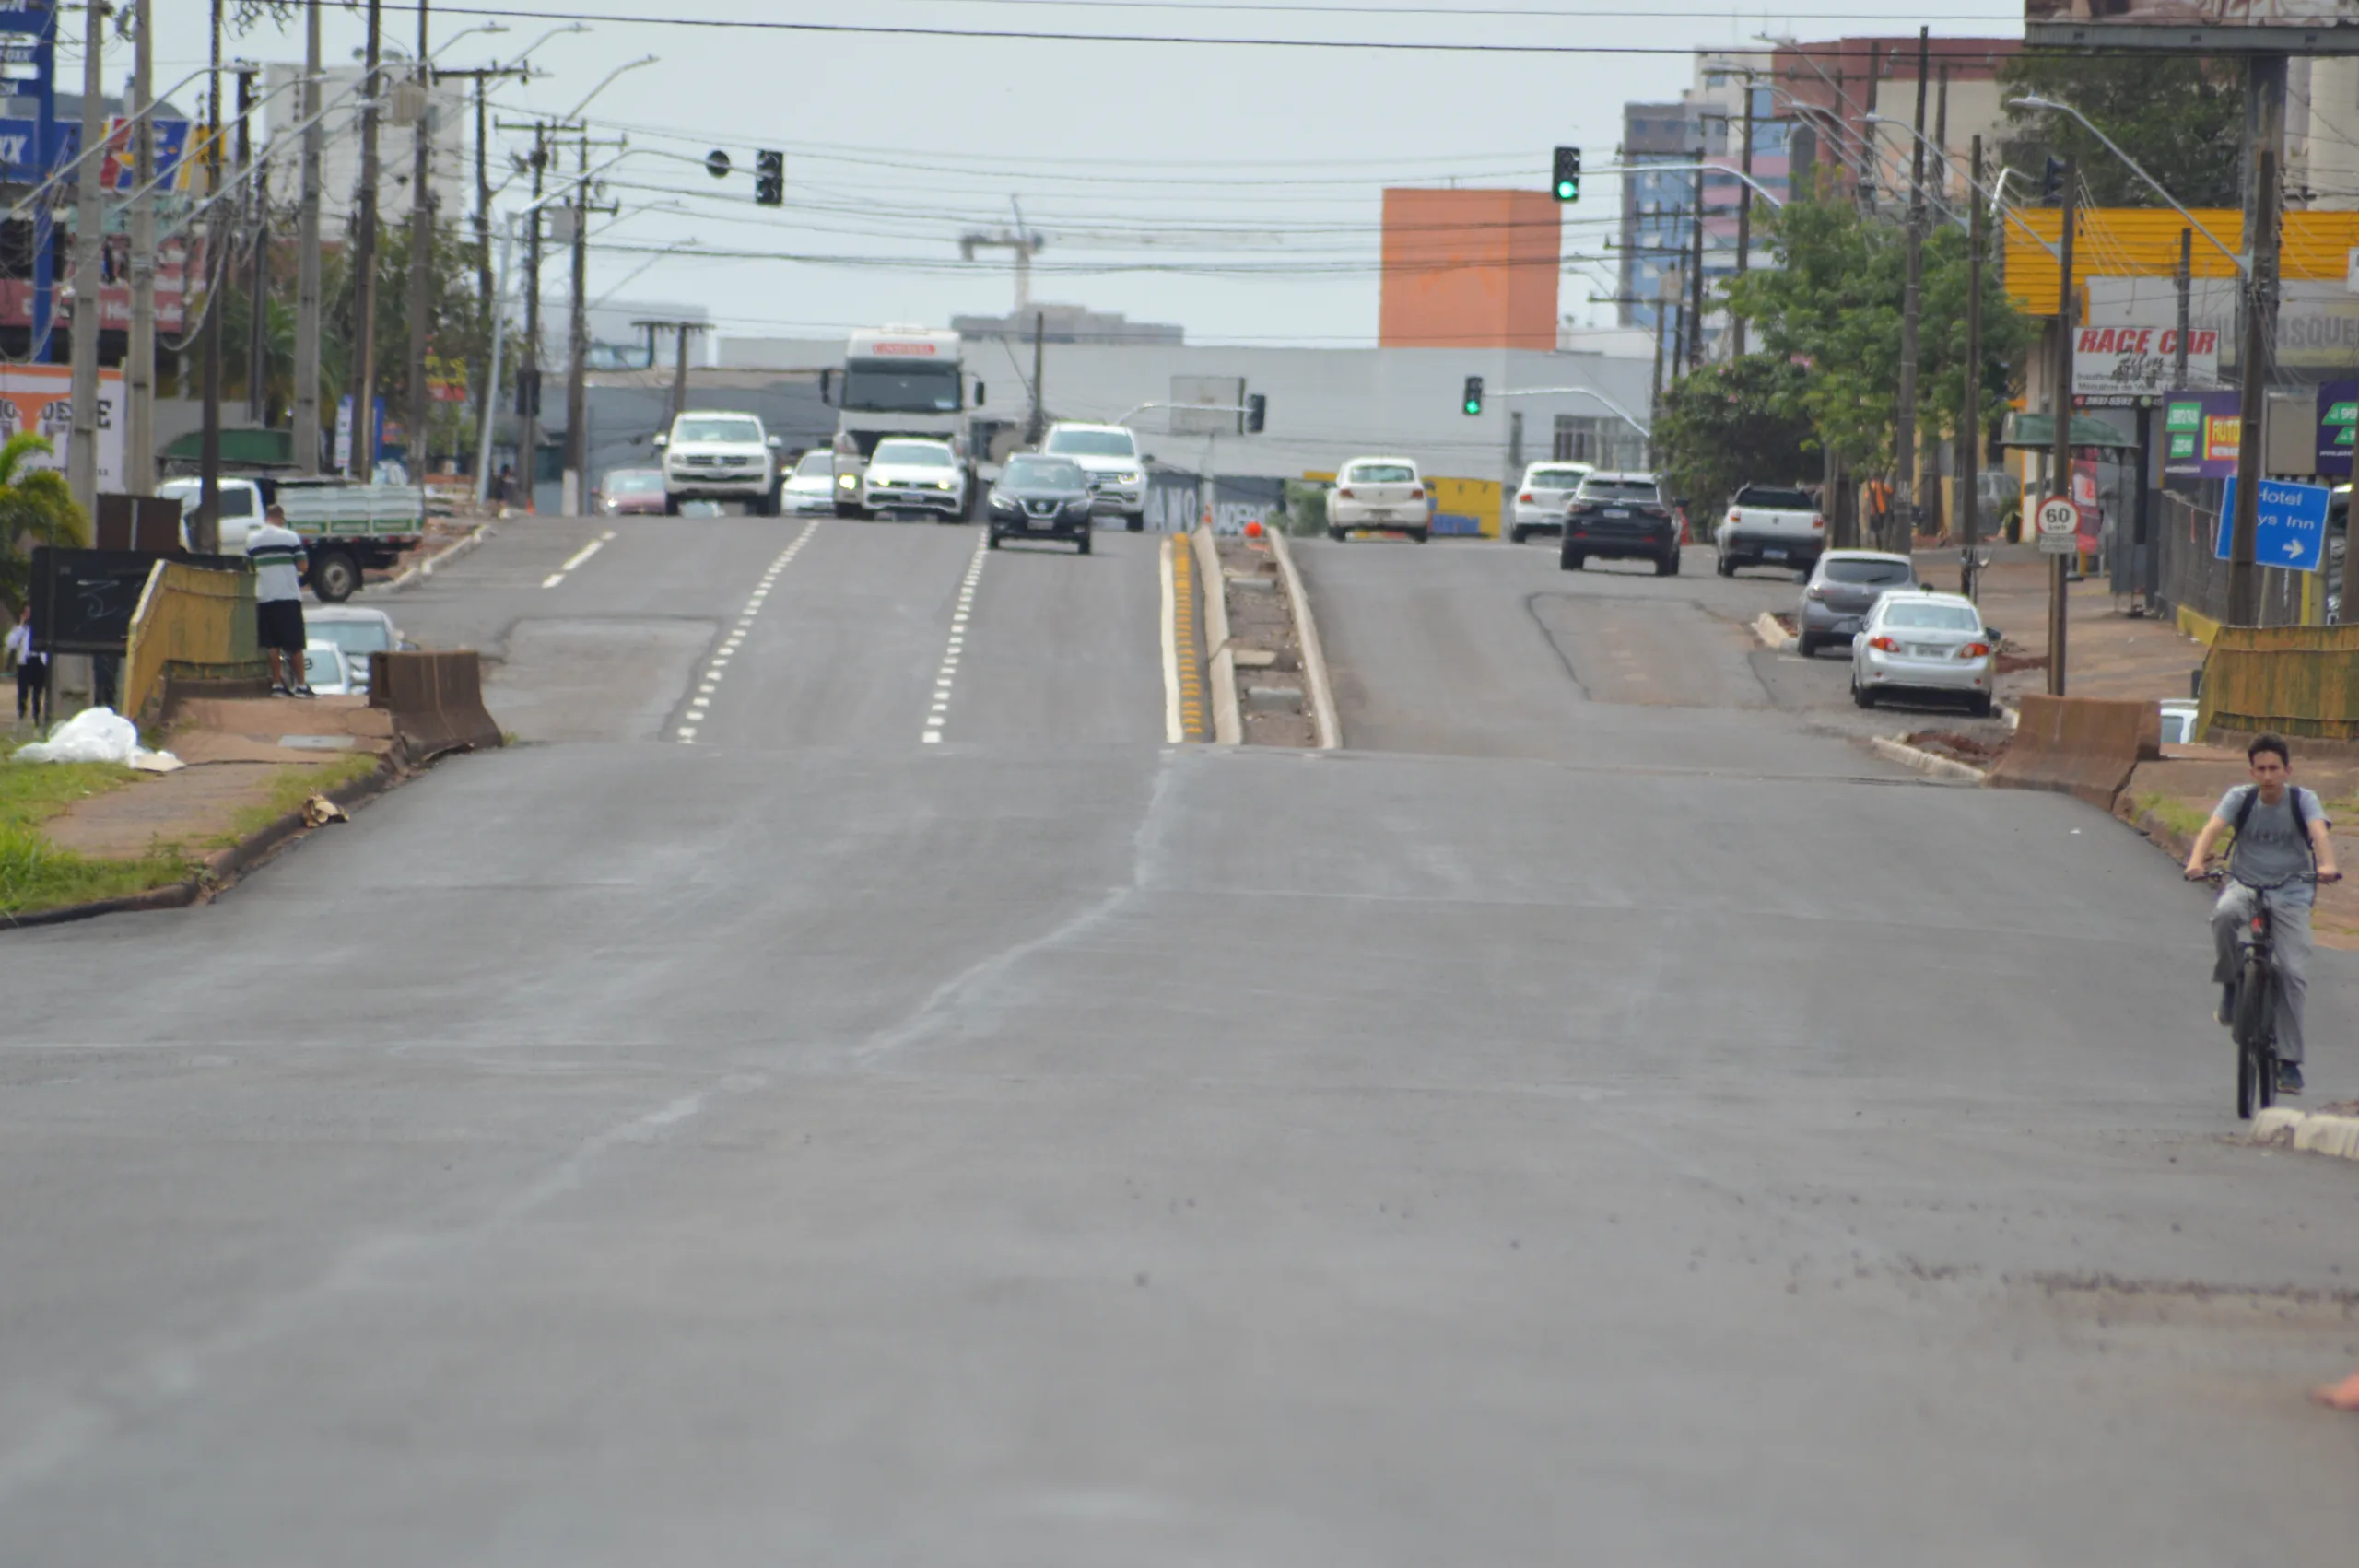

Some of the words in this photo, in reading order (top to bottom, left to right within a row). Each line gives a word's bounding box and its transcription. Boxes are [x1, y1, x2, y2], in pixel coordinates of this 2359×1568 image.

[2078, 329, 2153, 354] RACE
[2045, 508, 2071, 523] 60
[2286, 515, 2315, 530] Inn
